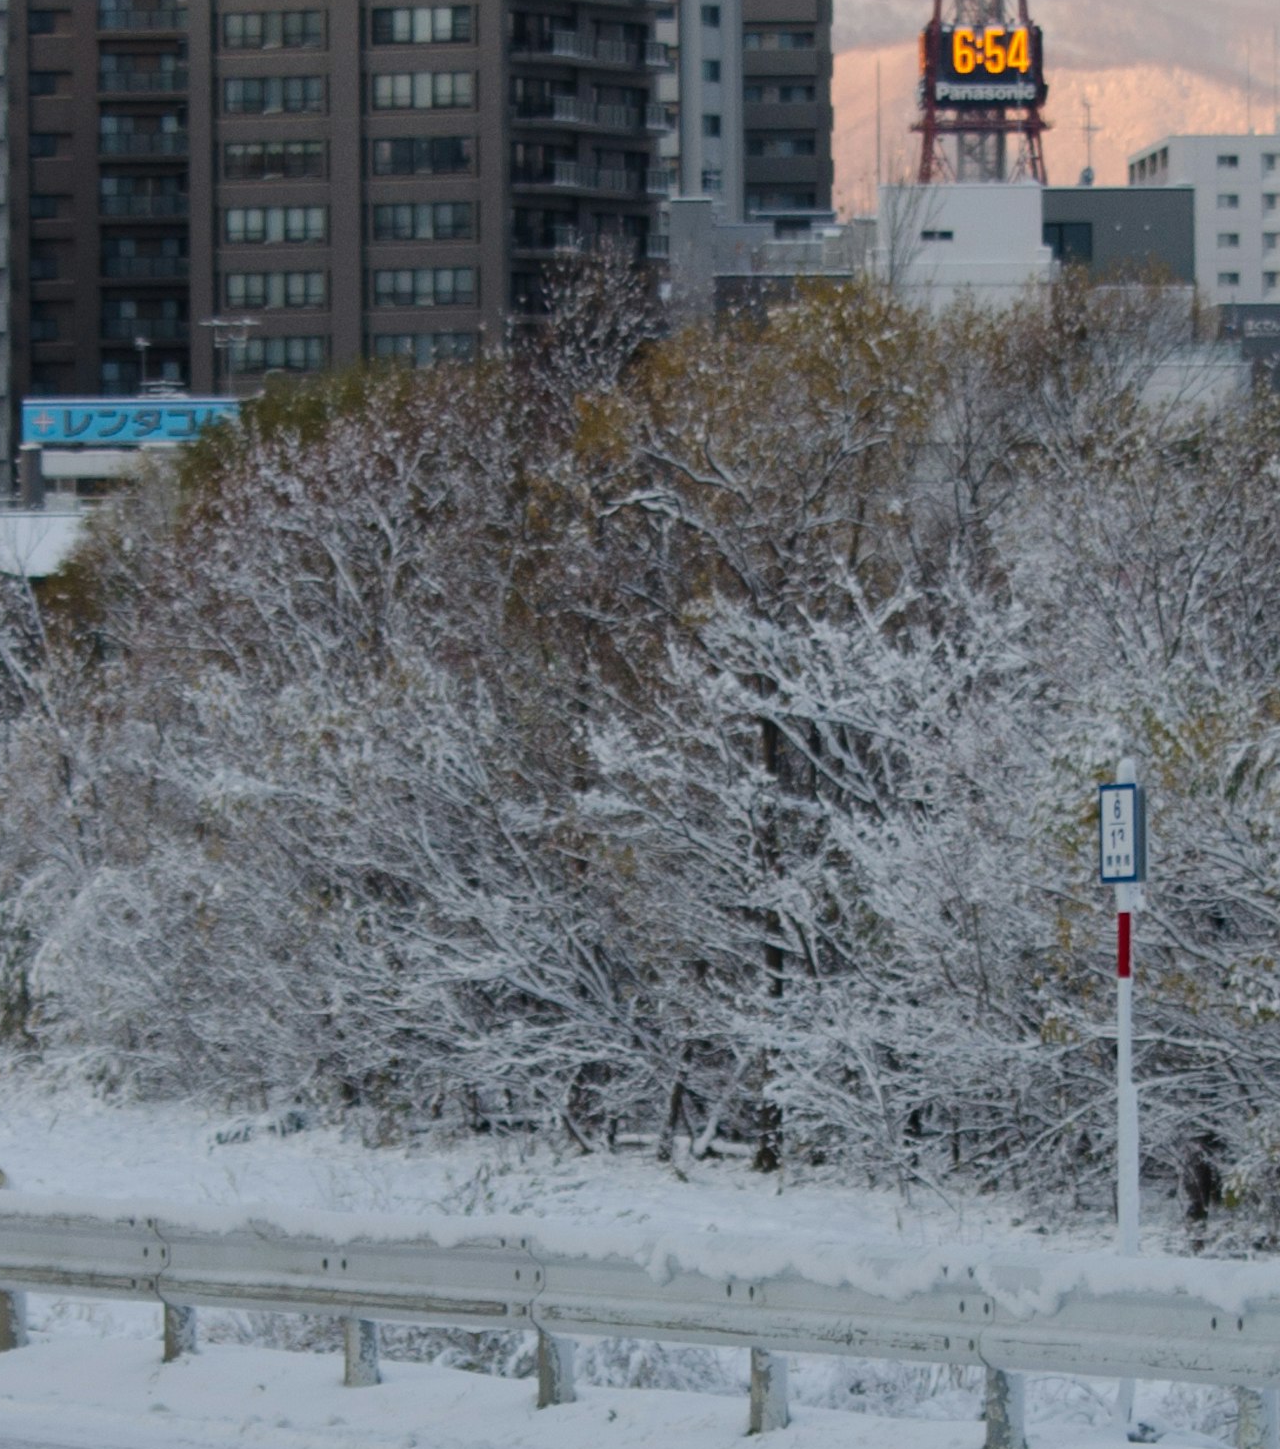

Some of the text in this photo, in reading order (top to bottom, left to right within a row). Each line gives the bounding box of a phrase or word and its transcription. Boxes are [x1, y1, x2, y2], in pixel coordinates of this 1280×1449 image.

[953, 28, 1030, 74] 6:54
[935, 82, 1036, 101] Panasonic
[63, 408, 217, 438] レンタコ
[1114, 799, 1121, 819] 6
